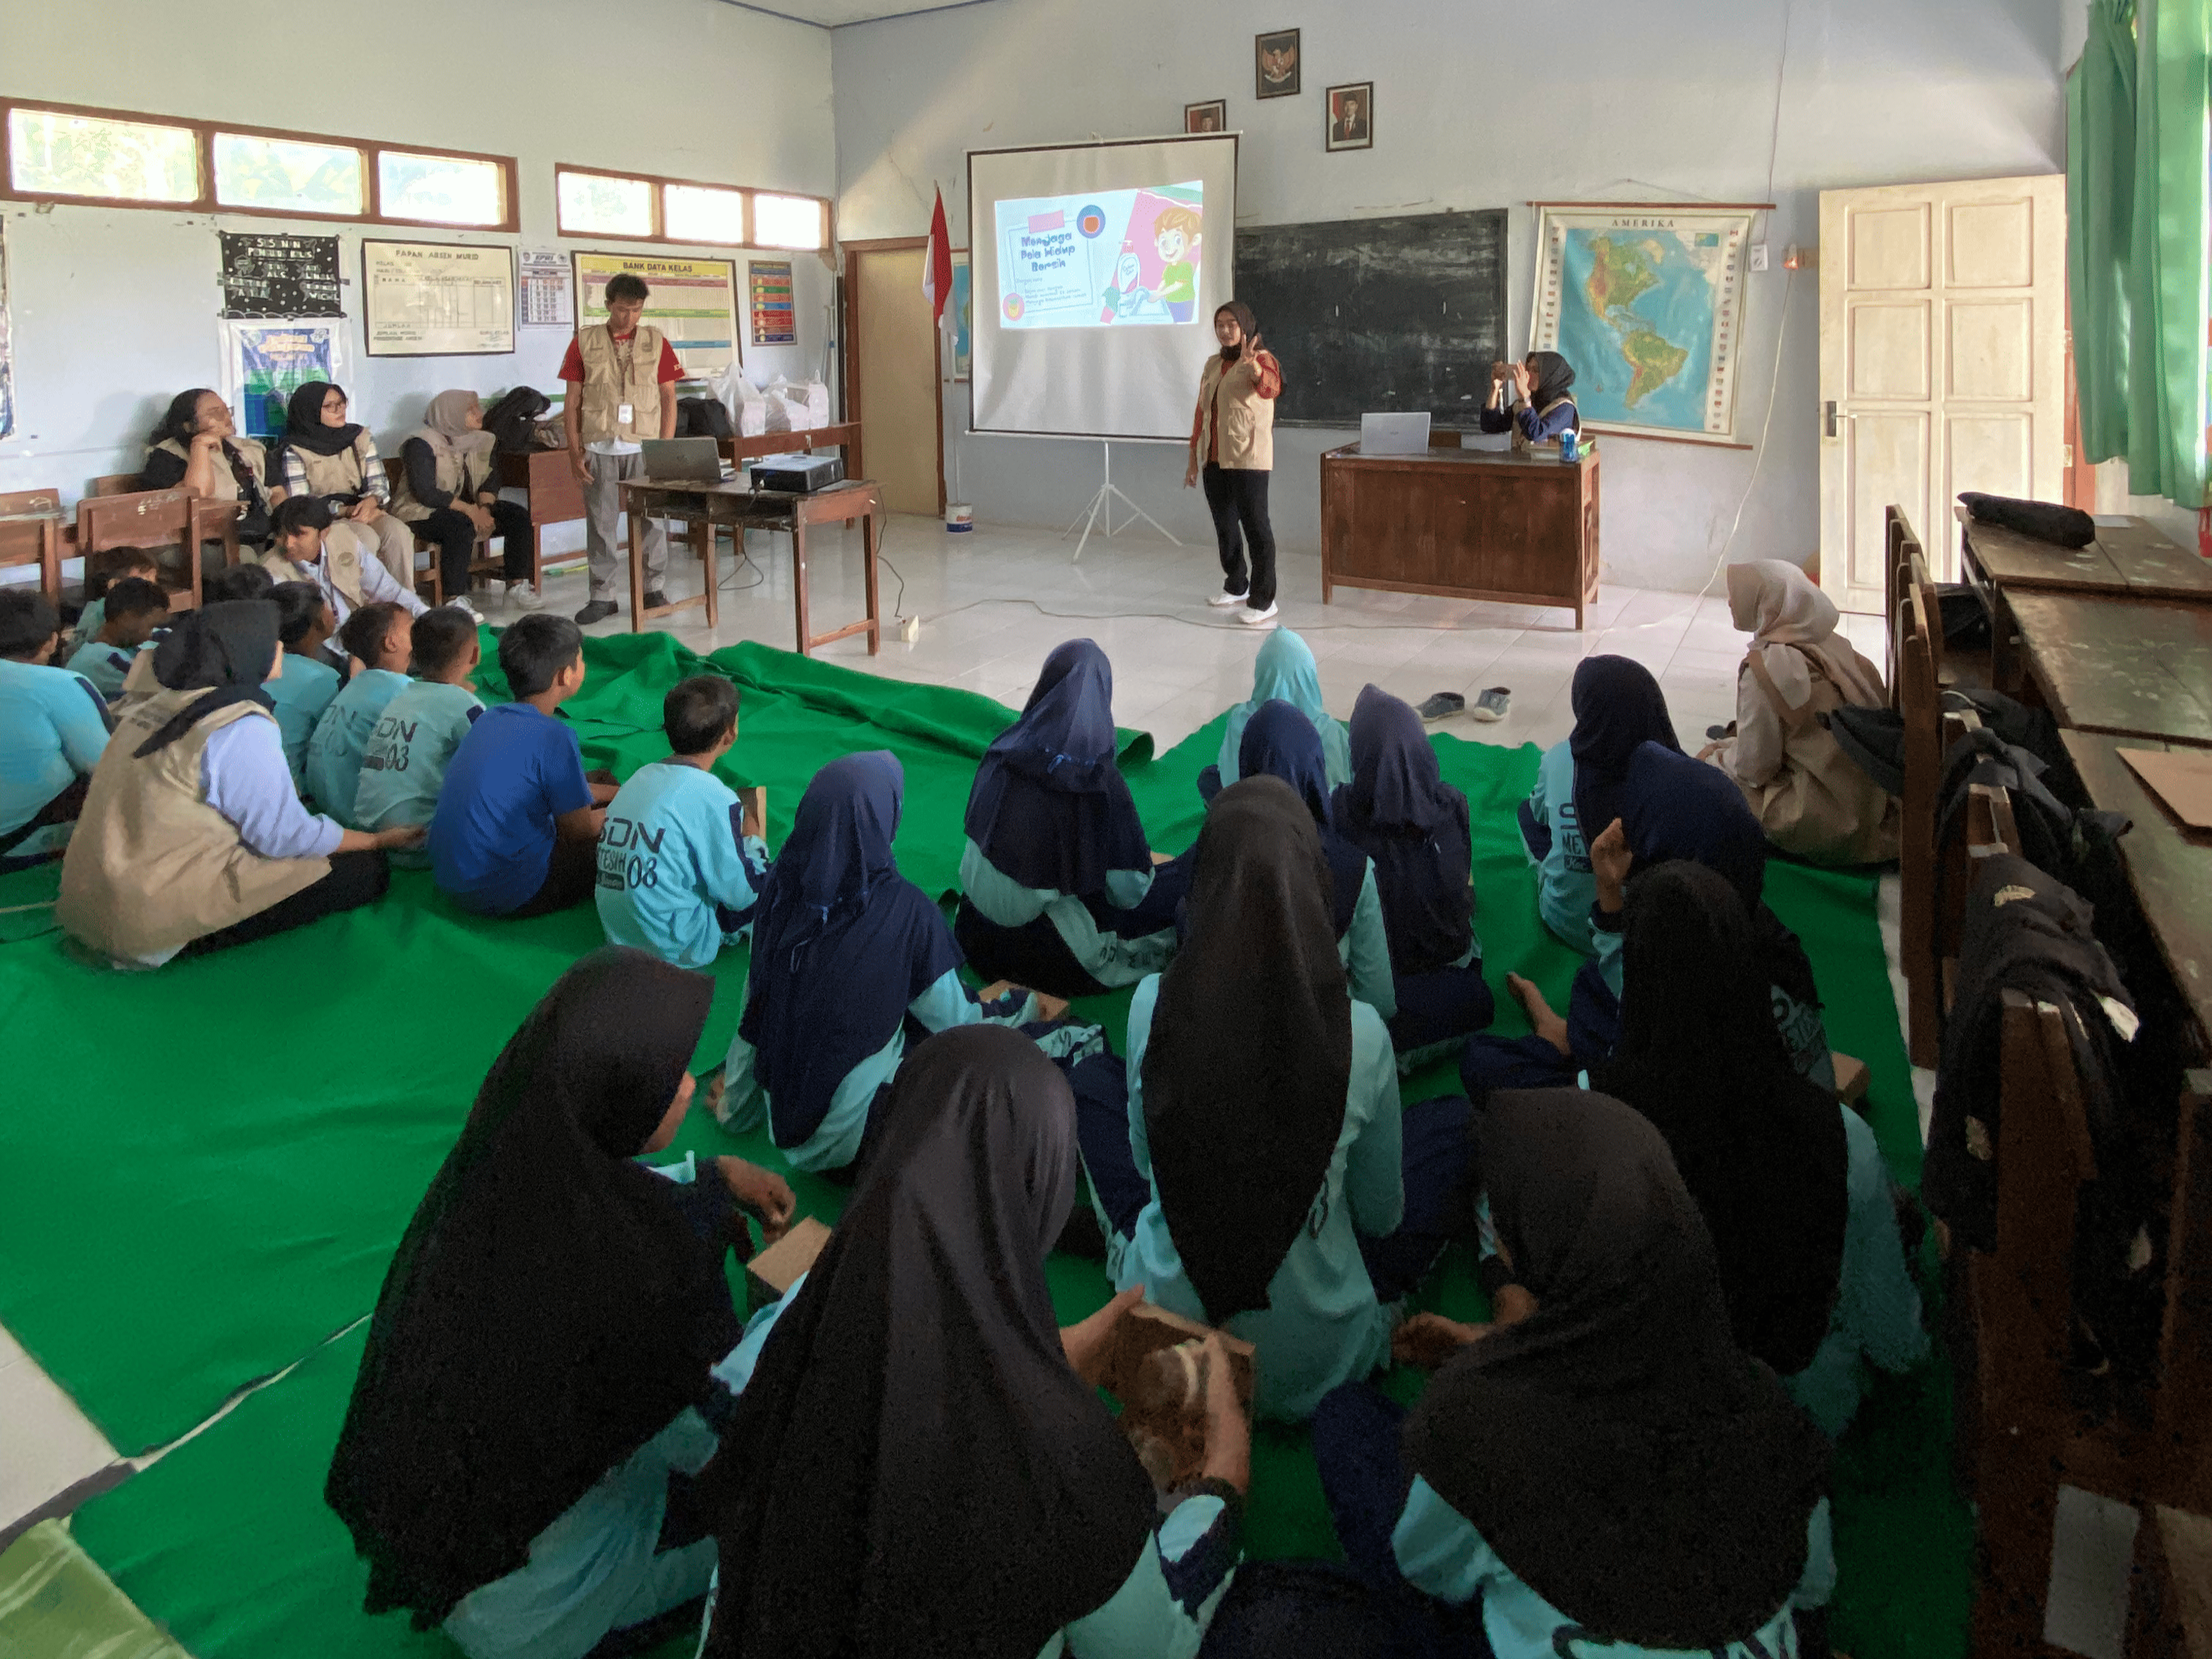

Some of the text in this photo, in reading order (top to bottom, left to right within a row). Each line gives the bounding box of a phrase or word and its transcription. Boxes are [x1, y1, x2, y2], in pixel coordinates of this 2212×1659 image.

[1612, 219, 1674, 227] AMERIKA
[1022, 233, 1072, 247] Menjaga
[1021, 246, 1075, 260] Pola Hidup
[623, 262, 693, 272] BANK DATA KELAS
[1031, 258, 1066, 271] Bersih
[376, 717, 418, 742] DN
